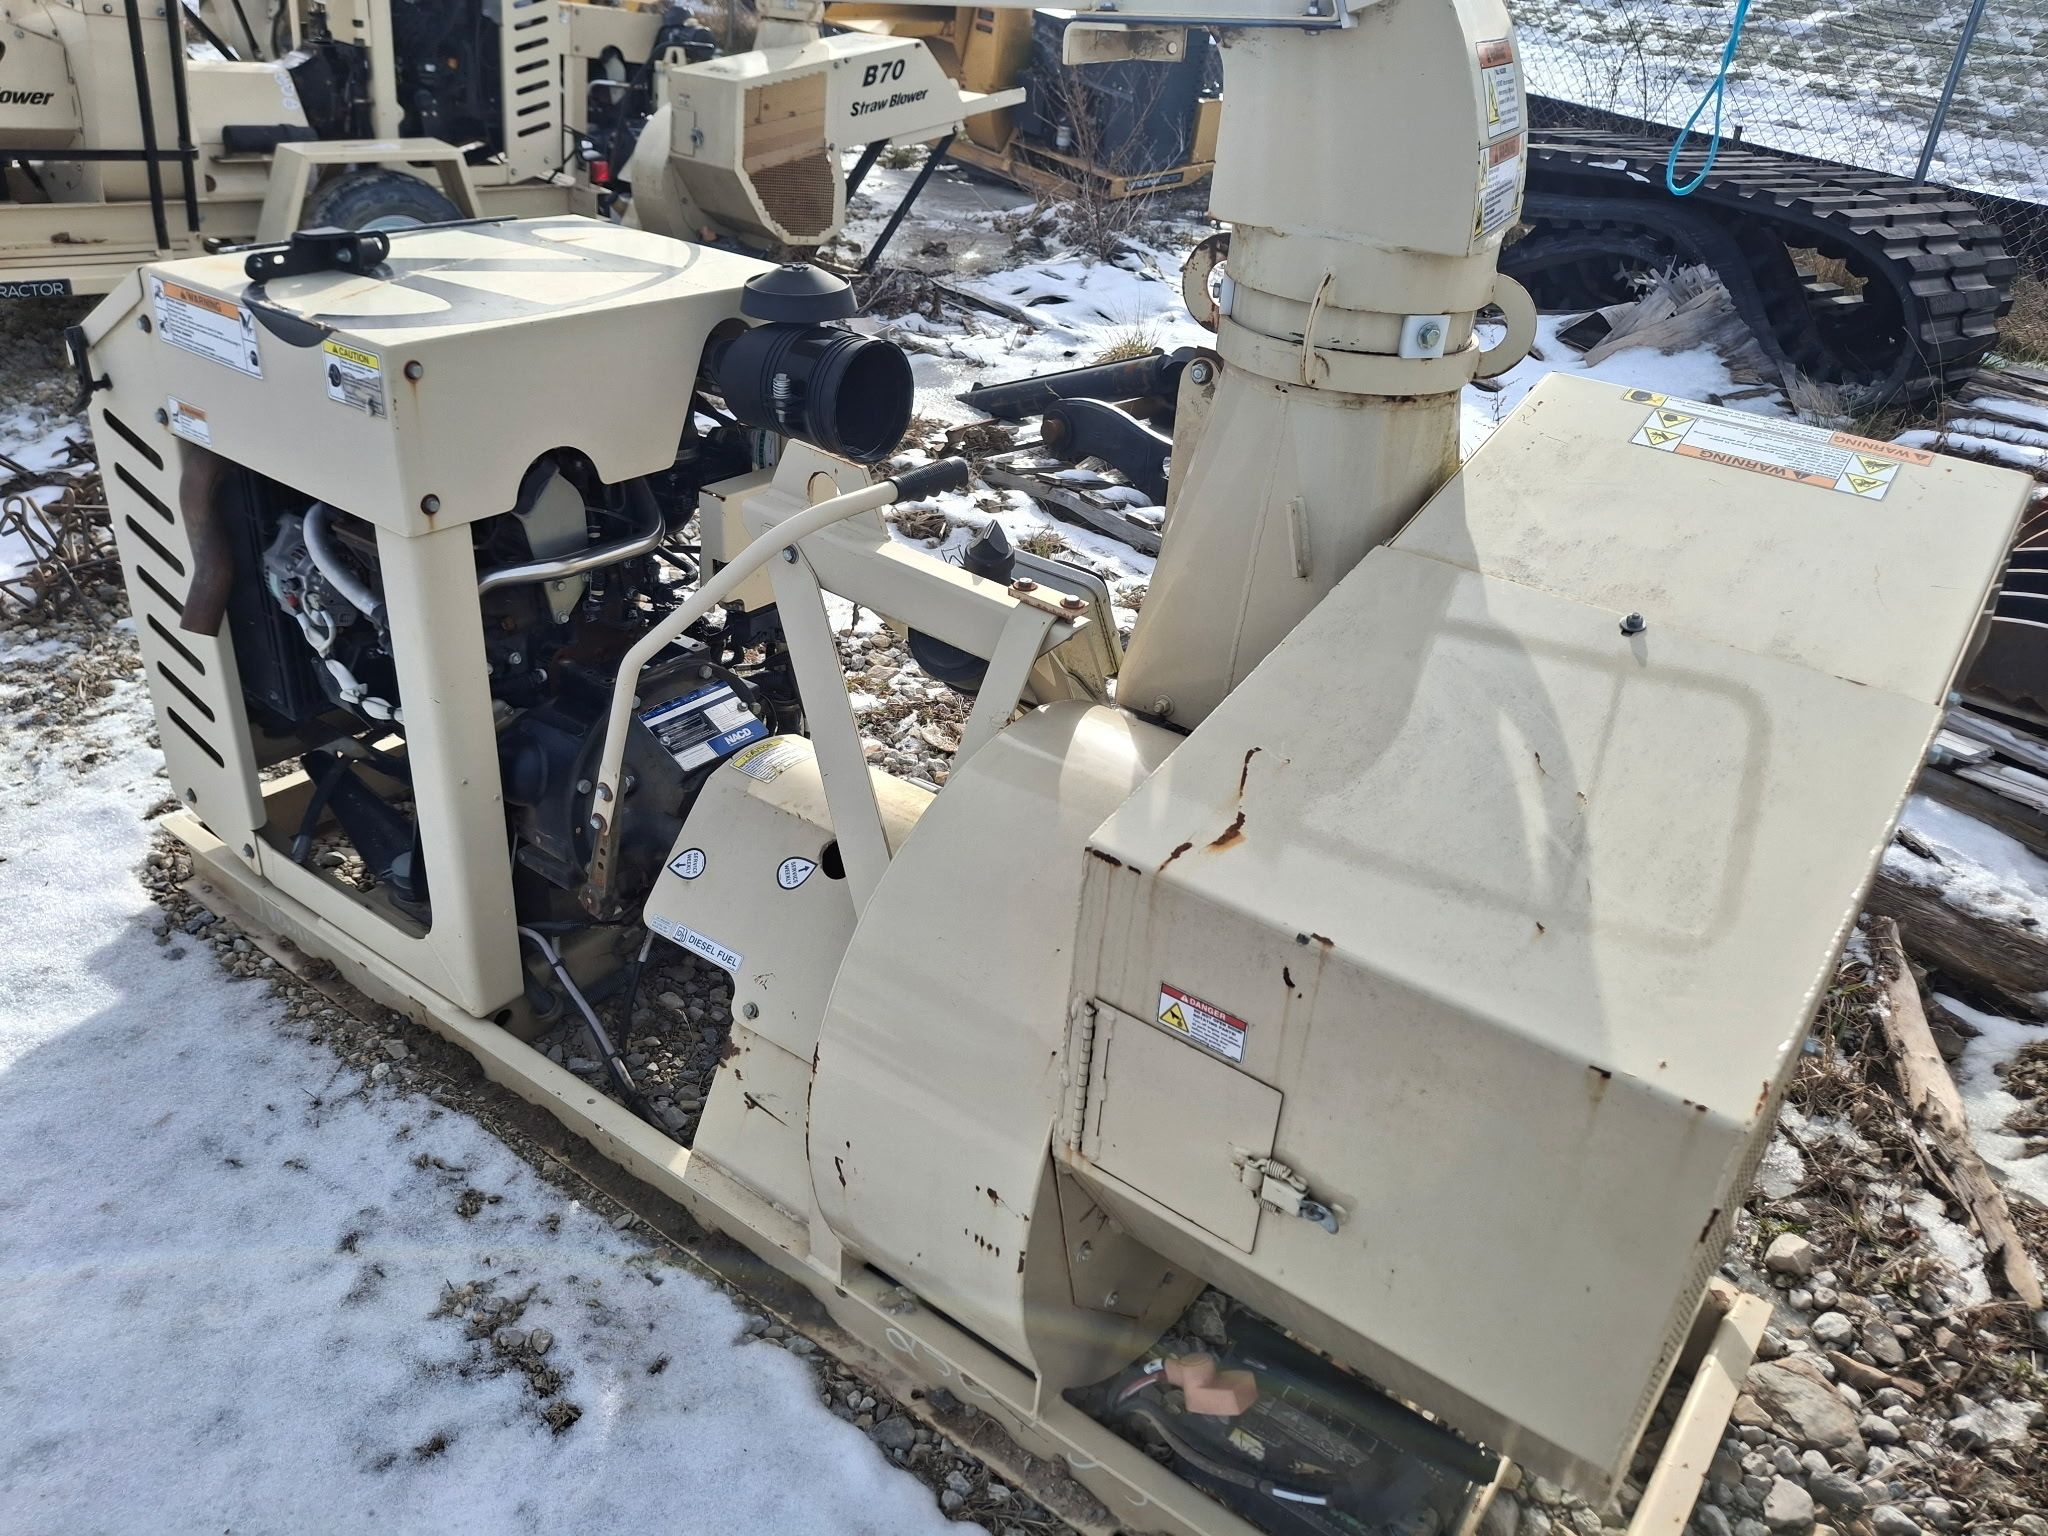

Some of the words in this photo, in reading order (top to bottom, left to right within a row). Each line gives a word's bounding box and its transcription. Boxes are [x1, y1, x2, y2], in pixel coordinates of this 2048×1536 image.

[862, 58, 906, 87] B70
[0, 90, 54, 105] ower
[850, 99, 888, 117] Straw
[889, 89, 929, 108] Blower
[338, 347, 370, 364] CAUTION
[1833, 436, 1910, 459] WARNING
[1699, 449, 1787, 476] WARNING
[784, 864, 792, 886] WEEKLY
[790, 861, 799, 884] SERVICE
[688, 935, 715, 956] DIESEL
[717, 950, 737, 968] FUEL
[1189, 998, 1226, 1020] DANGER
